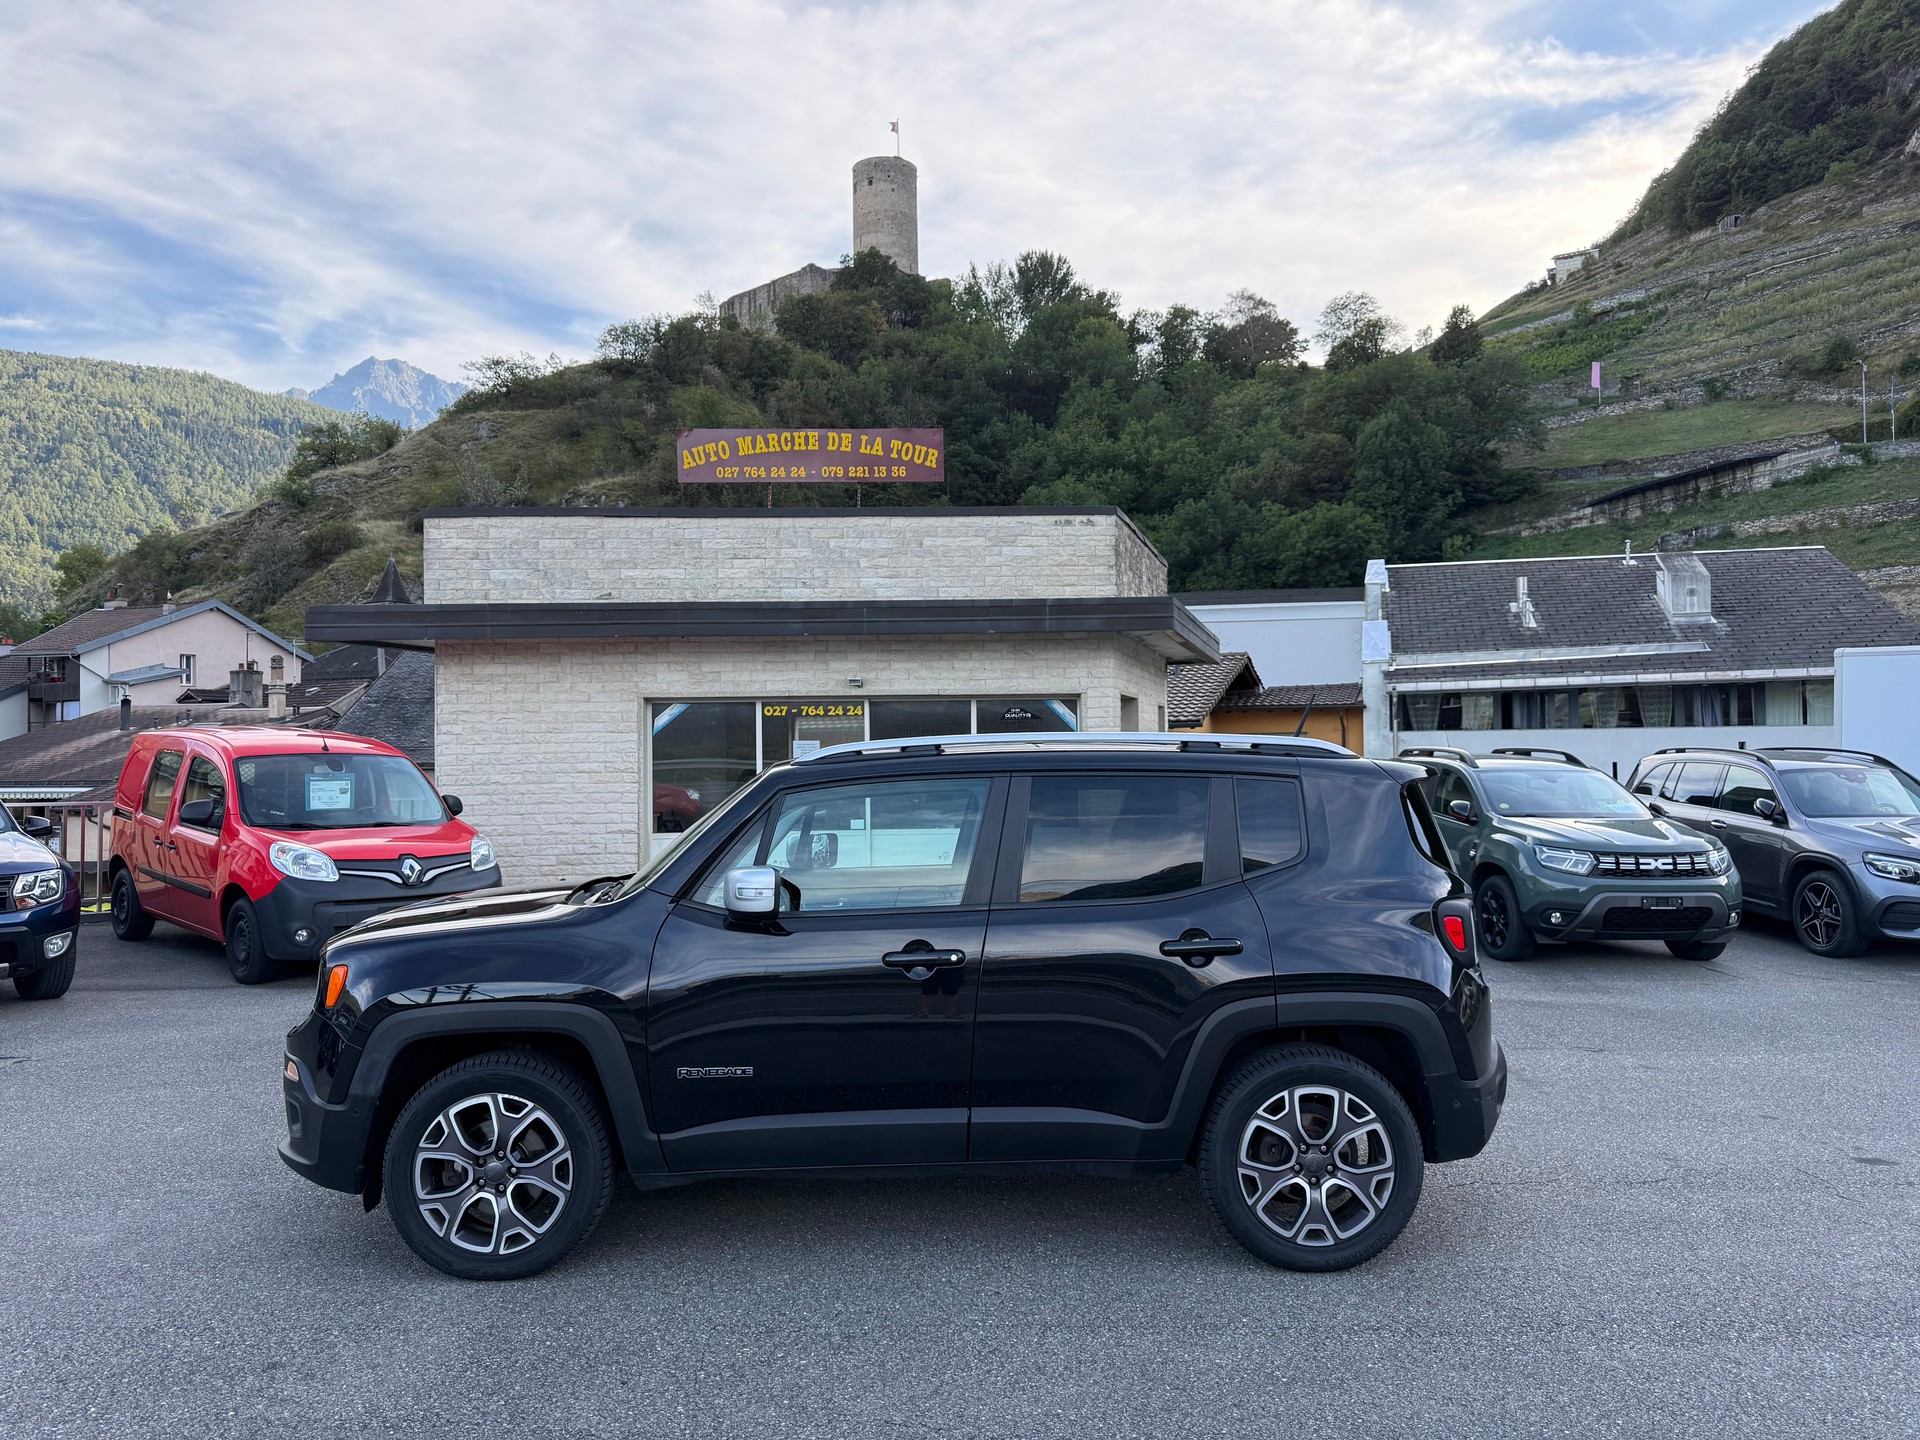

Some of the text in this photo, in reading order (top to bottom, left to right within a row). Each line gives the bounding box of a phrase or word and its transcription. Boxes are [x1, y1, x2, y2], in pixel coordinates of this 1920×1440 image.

[682, 431, 940, 469] AUTO MARCHE DE LA TOUR
[715, 465, 740, 479] 027
[743, 466, 767, 479] 764
[770, 465, 787, 479] 24
[790, 465, 807, 479] 24
[821, 465, 845, 479] 079
[848, 465, 870, 479] 221
[873, 465, 888, 479] 13
[891, 465, 907, 479] 36
[763, 705, 788, 717] 027
[800, 705, 825, 717] 764
[827, 705, 844, 717] 24
[846, 705, 863, 717] 24
[677, 1067, 754, 1079] RENEGADE
